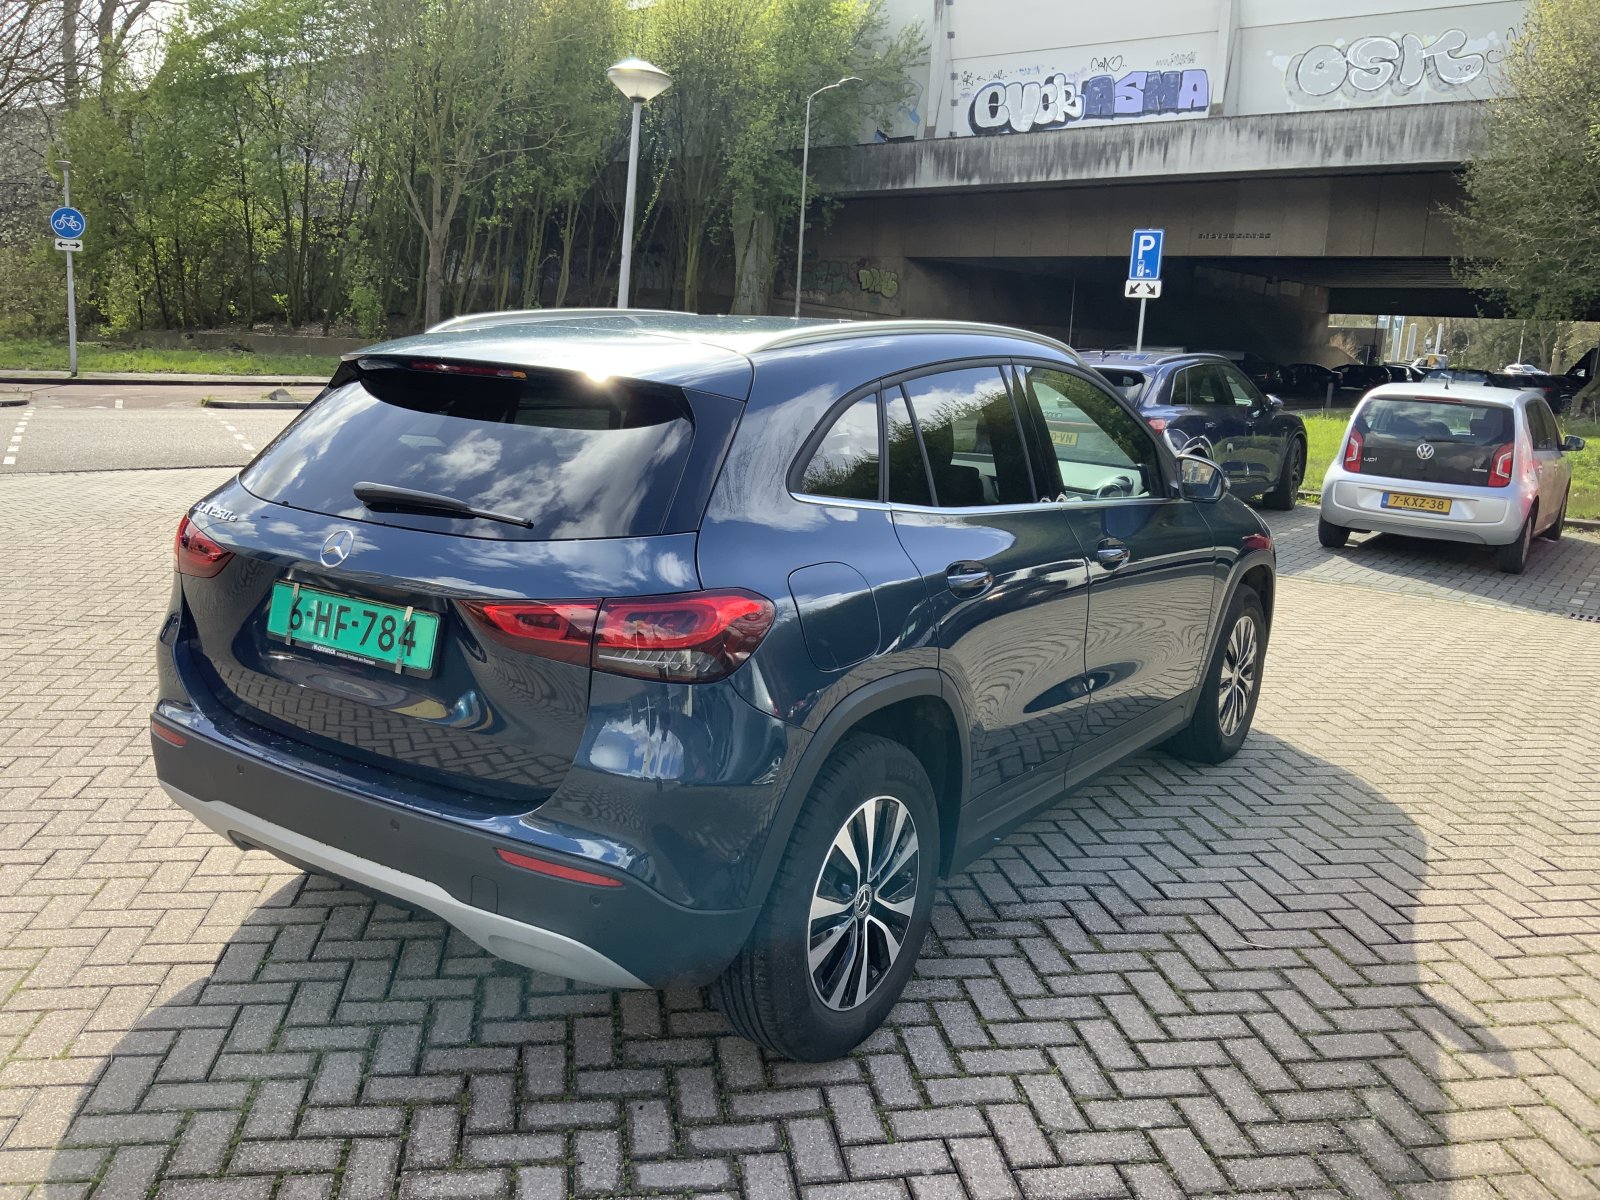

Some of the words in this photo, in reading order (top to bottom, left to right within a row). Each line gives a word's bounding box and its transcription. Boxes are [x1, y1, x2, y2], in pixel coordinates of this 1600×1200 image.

[1137, 235, 1156, 260] P
[1392, 495, 1445, 510] 7-KXZ-38
[289, 596, 416, 656] 6-HF-784
